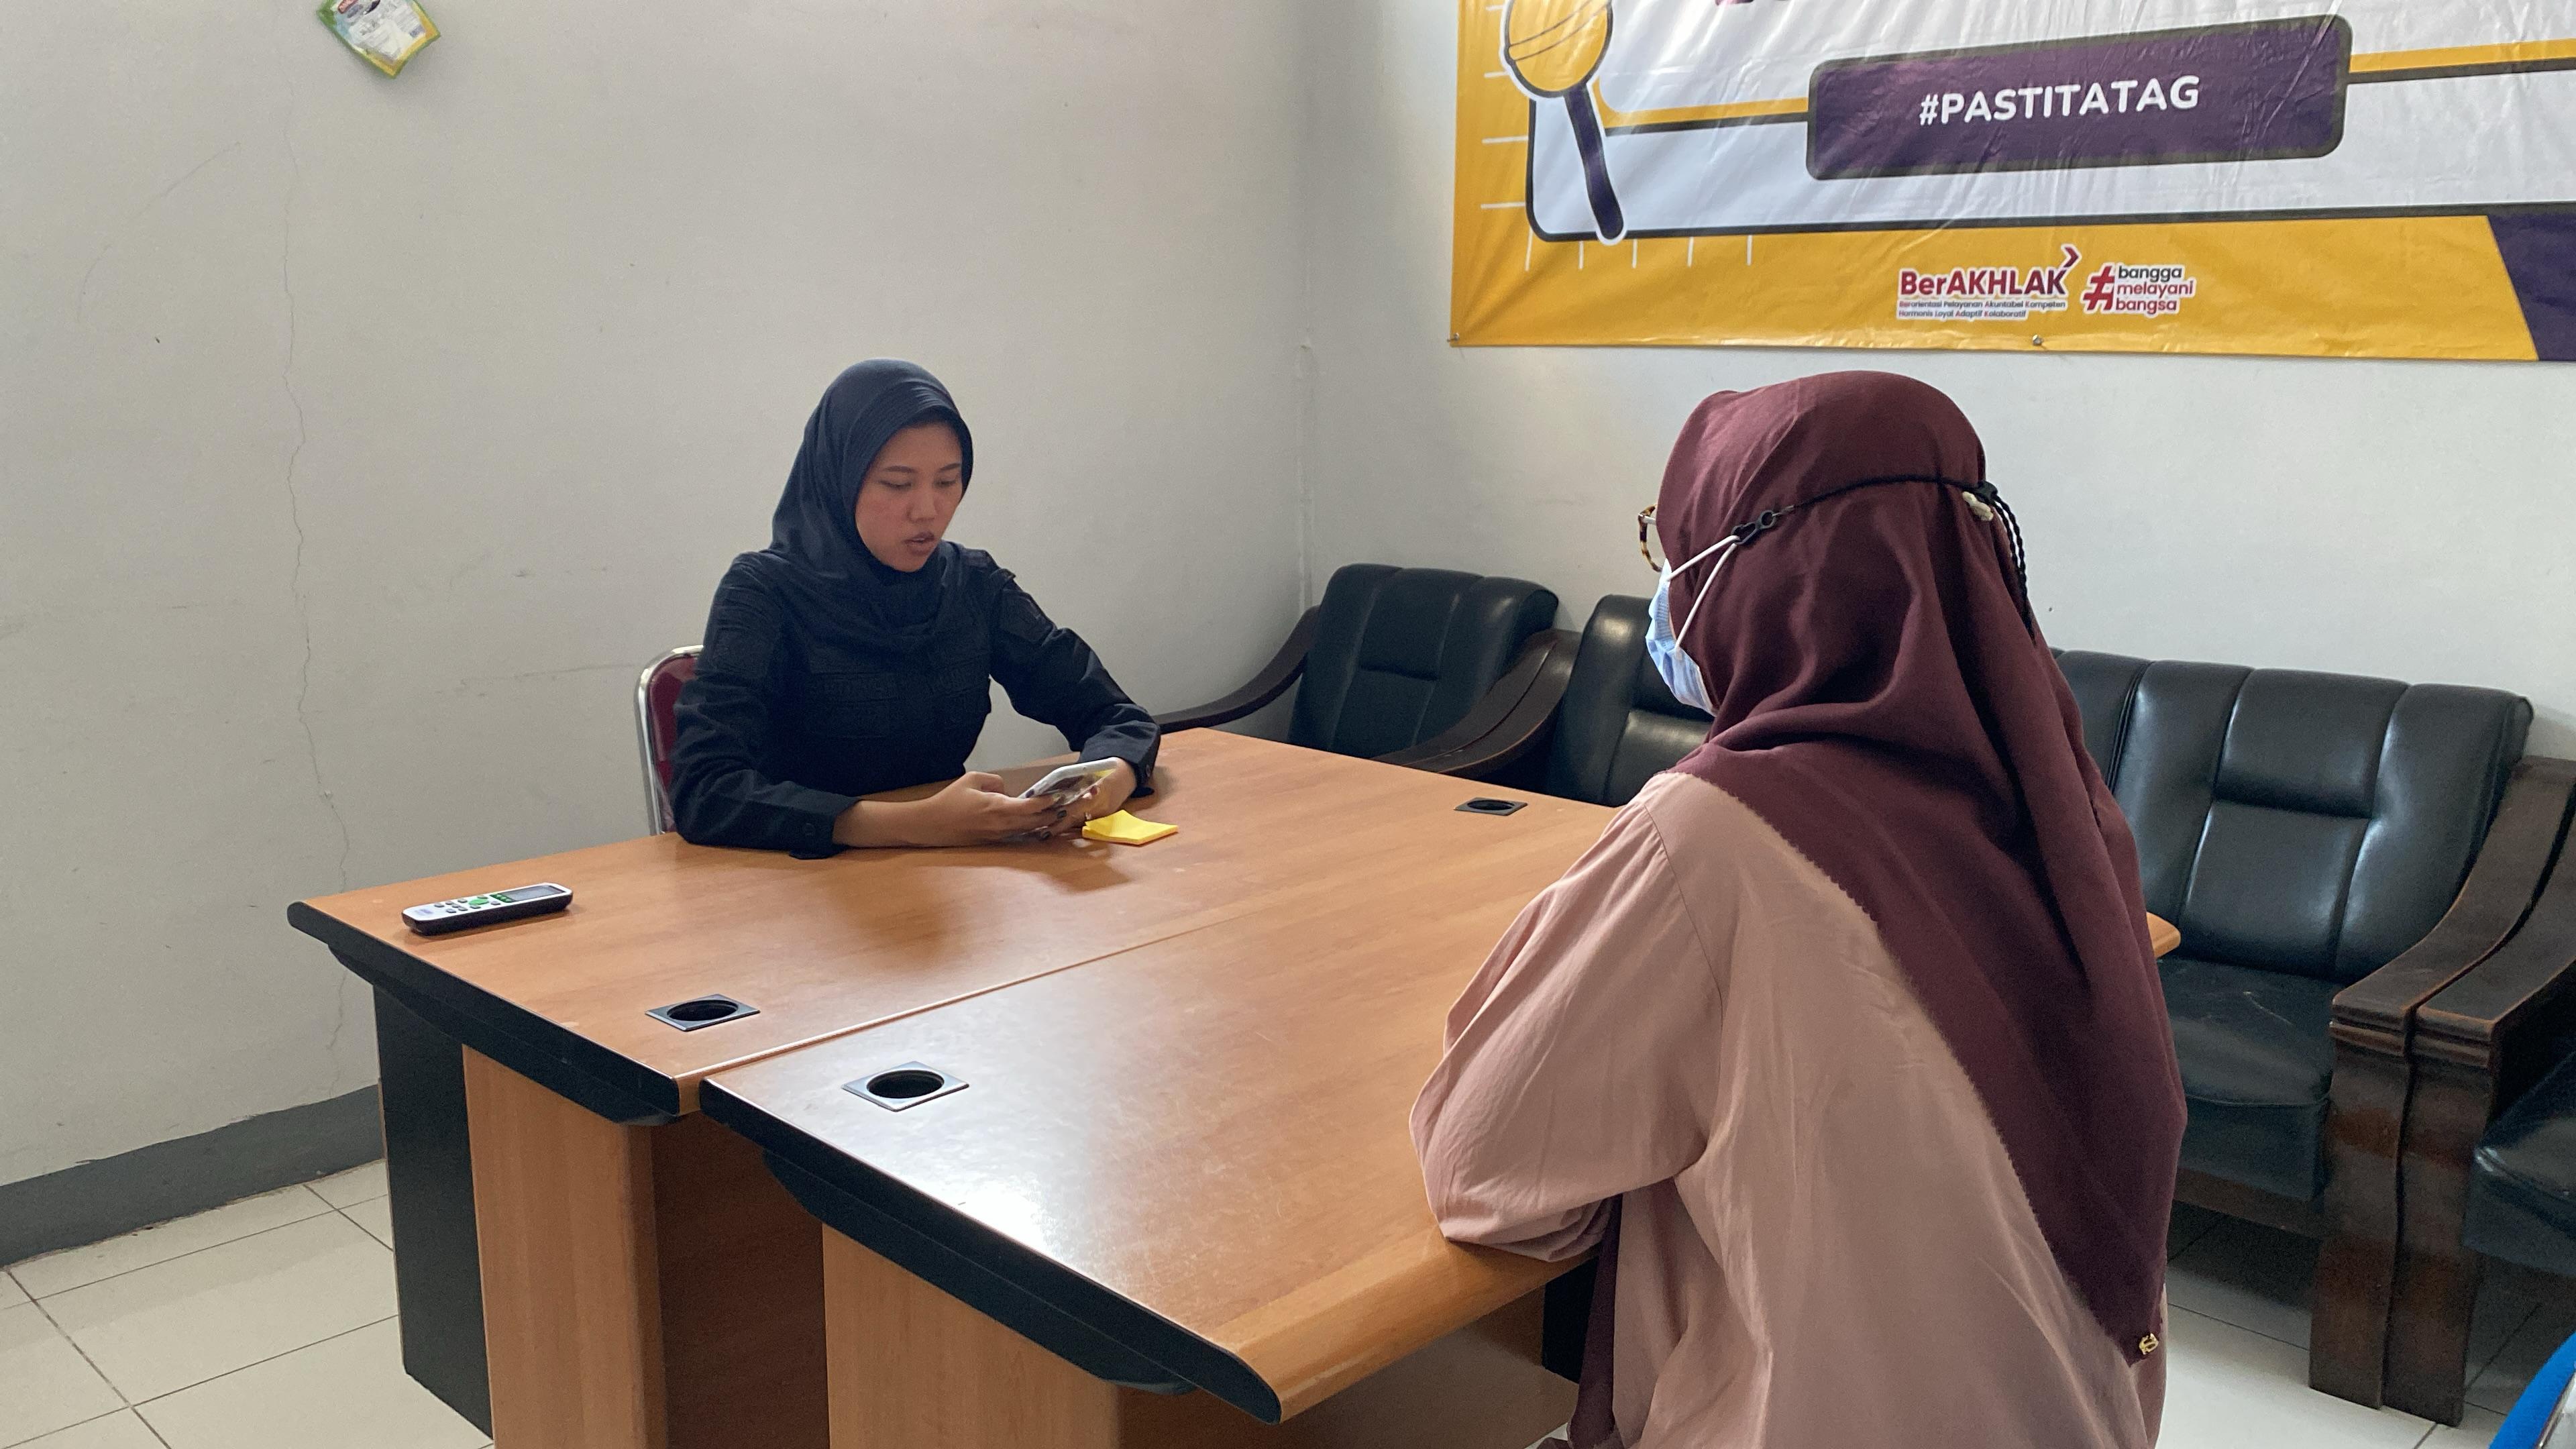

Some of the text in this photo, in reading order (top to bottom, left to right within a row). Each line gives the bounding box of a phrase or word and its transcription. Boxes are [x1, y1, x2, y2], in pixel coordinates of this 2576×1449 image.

[1919, 74, 2200, 126] #PASTITATAG
[1900, 269, 2068, 296] BerAKHLAK
[2118, 265, 2182, 283] bangga
[2116, 280, 2194, 299] melayani
[1898, 310, 2027, 319] Harmonis Loyal Adaptif Kolaboratif
[1943, 301, 1983, 311] Pelayanan
[1985, 300, 2024, 308] Akuntabel
[2025, 301, 2065, 311] Kompeten
[2115, 297, 2178, 315] bangsa
